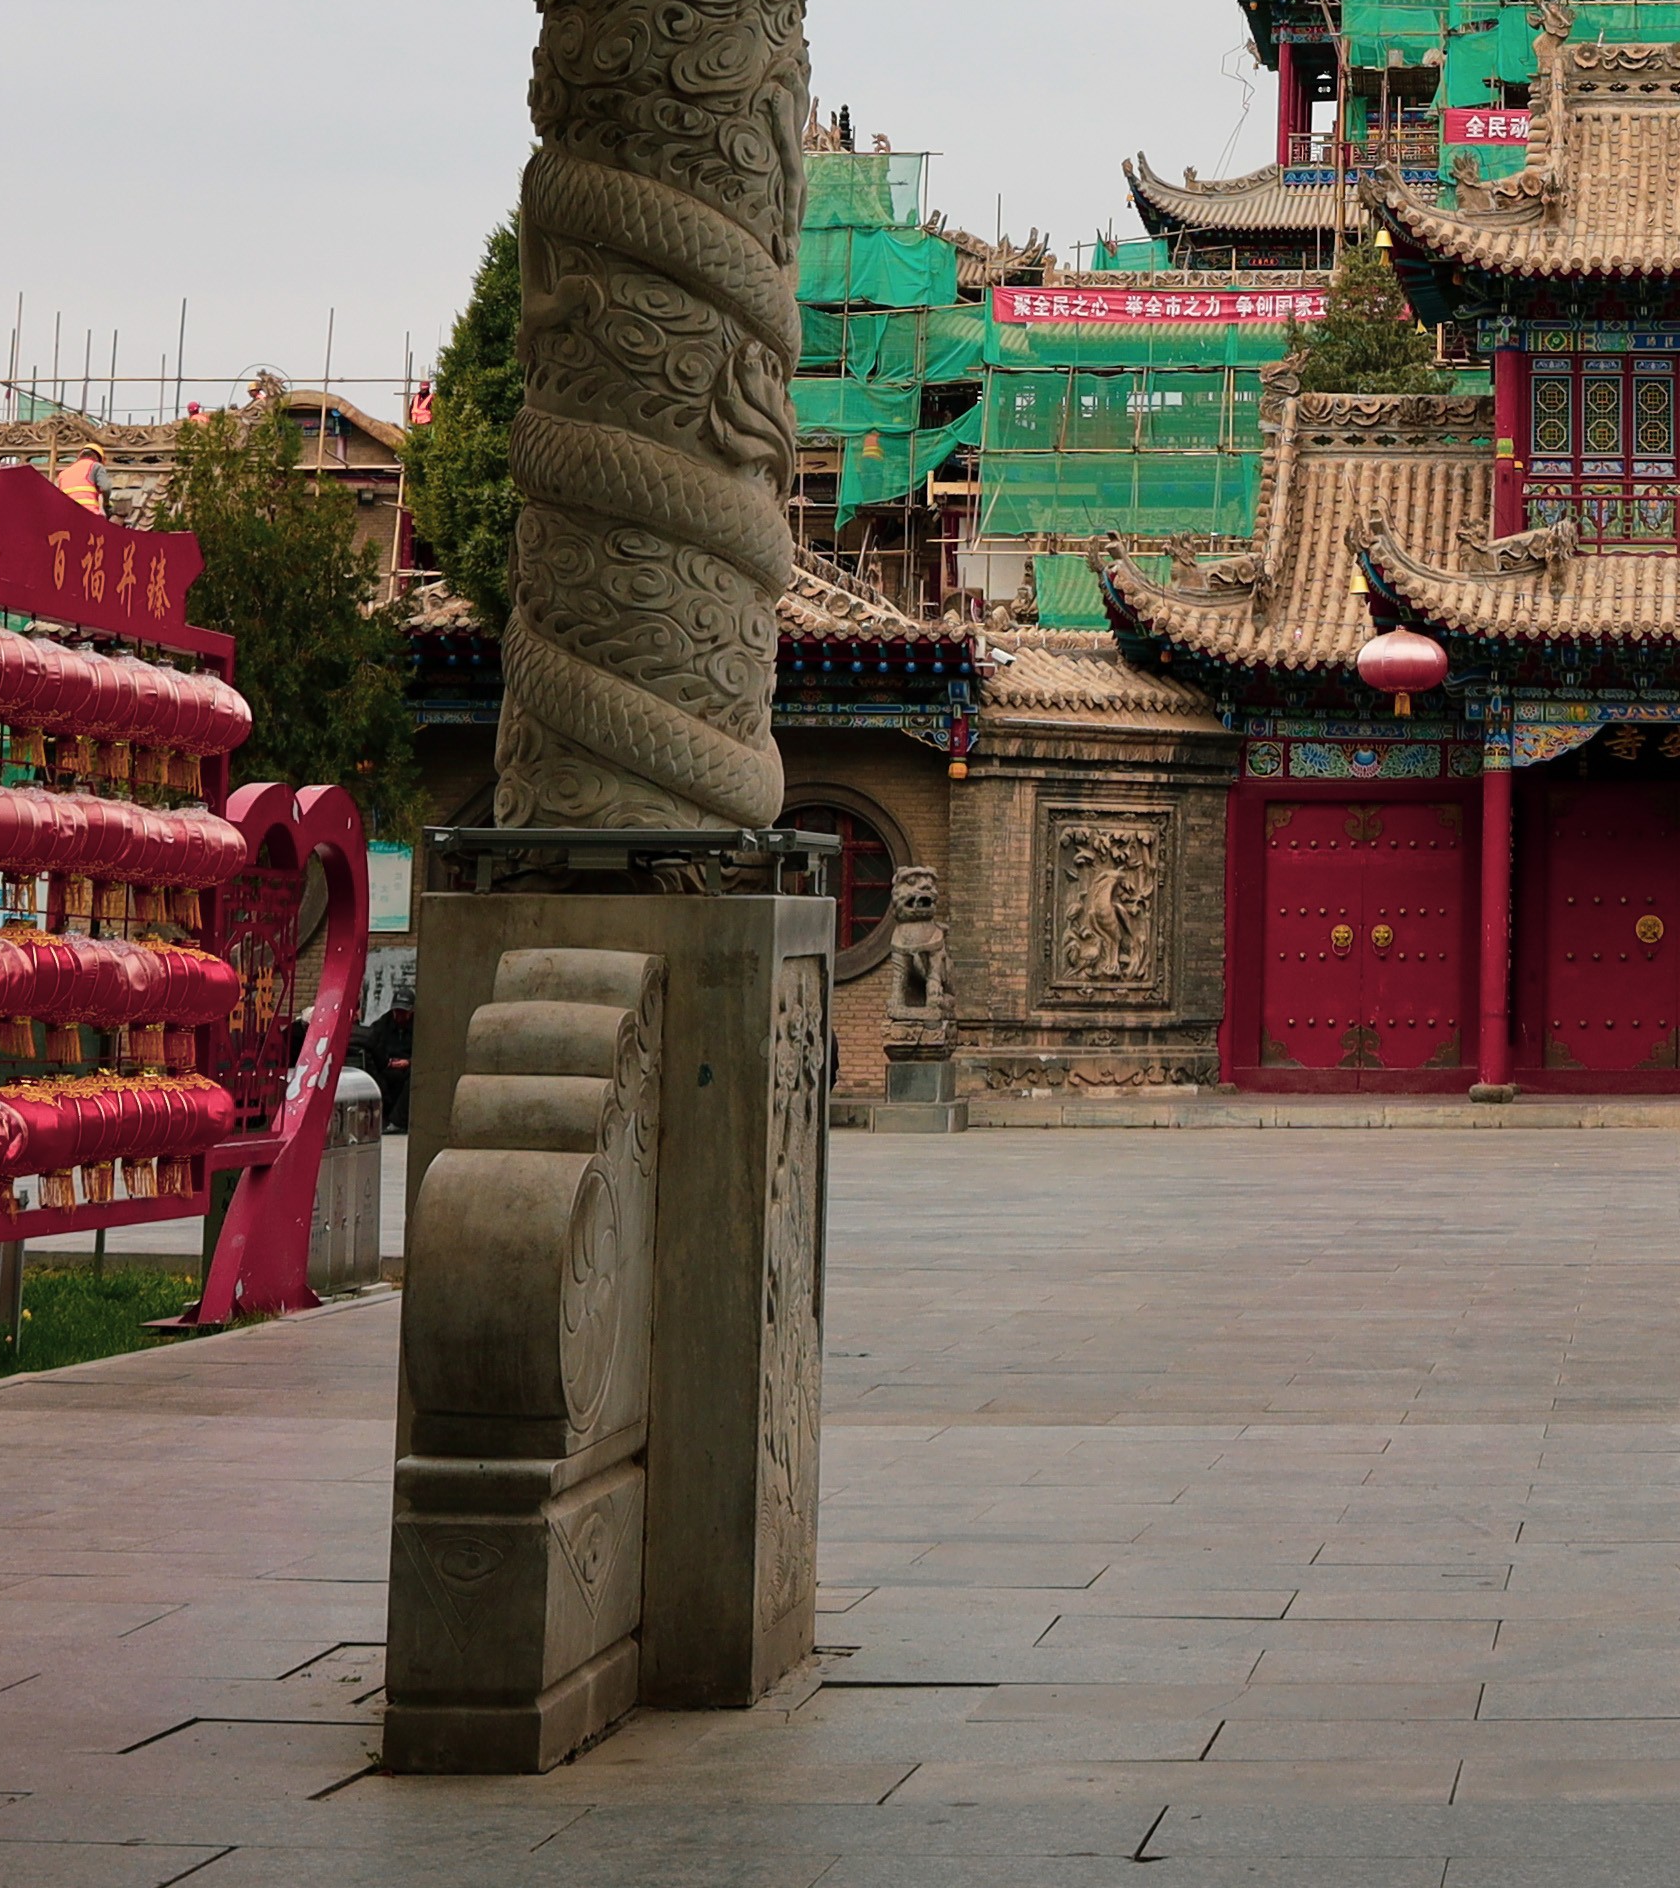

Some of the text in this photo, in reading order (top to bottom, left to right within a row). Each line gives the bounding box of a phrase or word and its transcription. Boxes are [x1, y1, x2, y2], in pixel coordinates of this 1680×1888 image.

[1013, 294, 1109, 318] 聚全民之心
[1124, 295, 1221, 318] 举全市之力
[48, 530, 171, 621] 百福并臻
